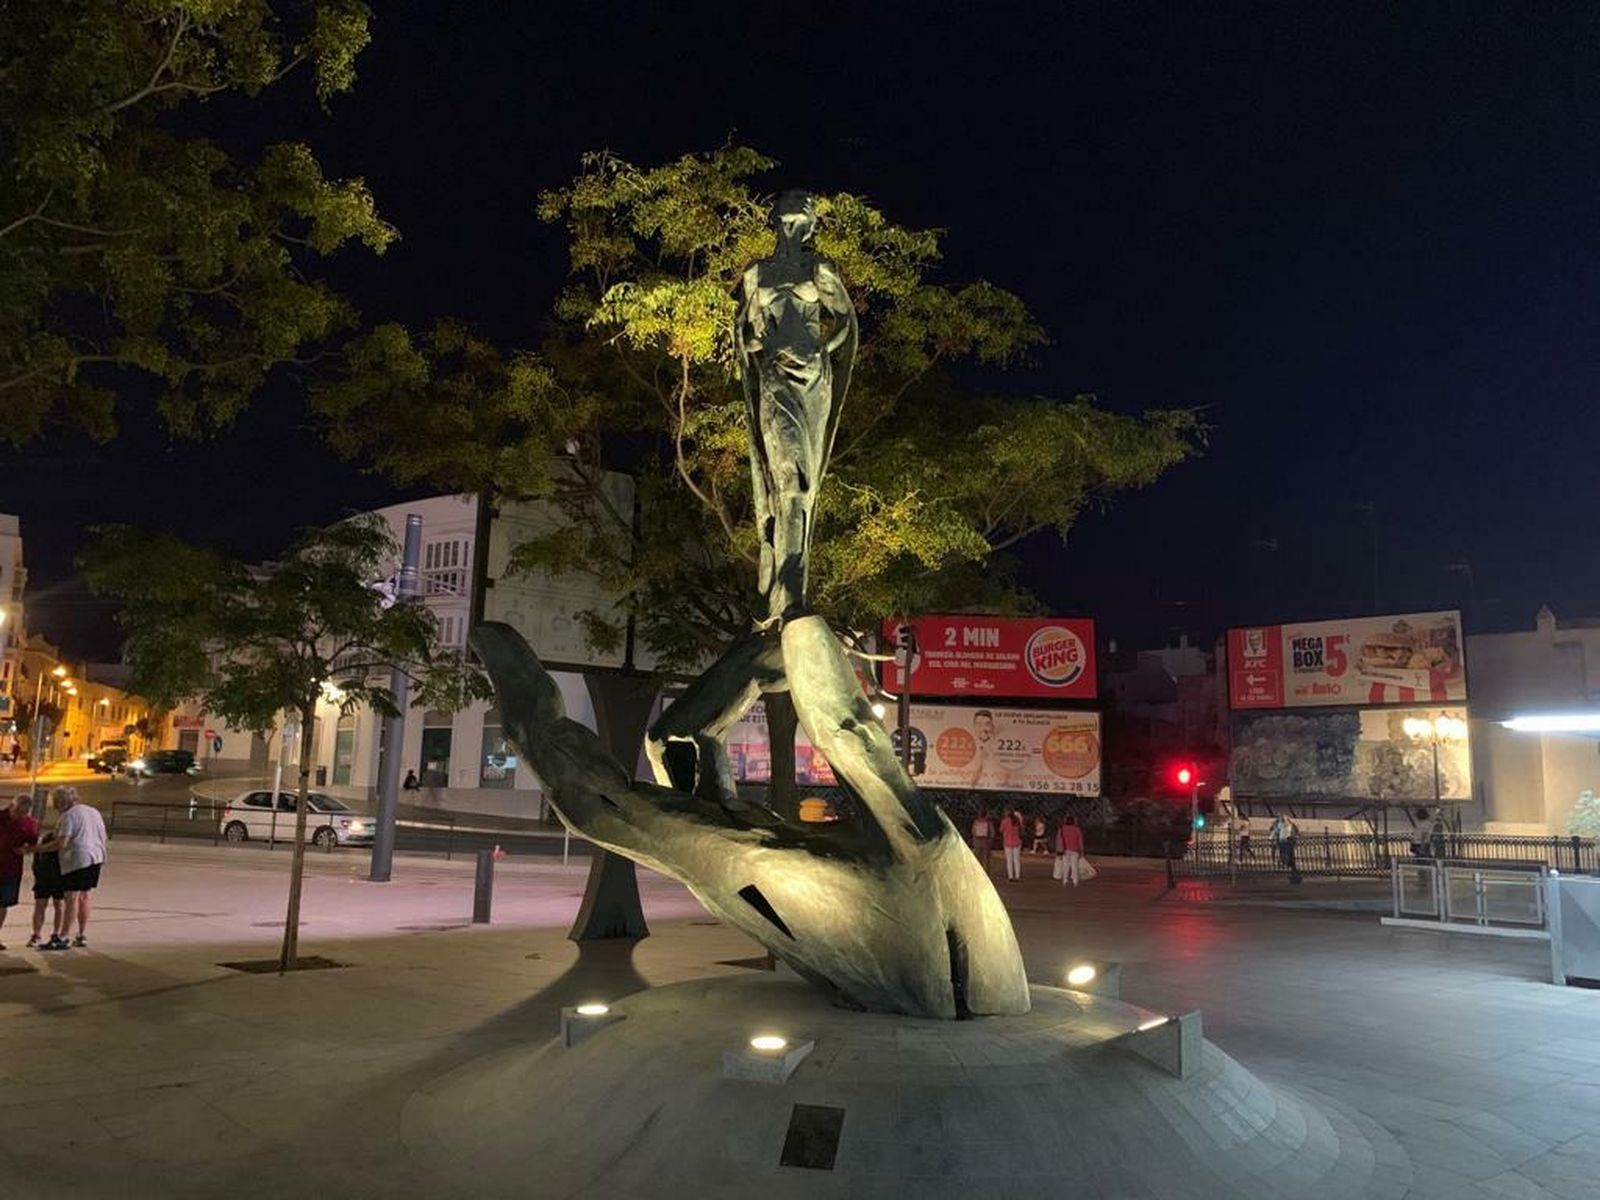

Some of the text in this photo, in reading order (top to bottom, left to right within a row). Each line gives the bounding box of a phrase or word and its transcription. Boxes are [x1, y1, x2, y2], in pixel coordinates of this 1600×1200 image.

[944, 627, 1000, 647] 2 MIN
[1292, 636, 1323, 650] MEGA
[1033, 638, 1076, 658] BURGER
[1034, 648, 1079, 671] KING
[1244, 659, 1266, 669] KFC
[1293, 650, 1324, 668] BOX
[1029, 780, 1048, 790] 956
